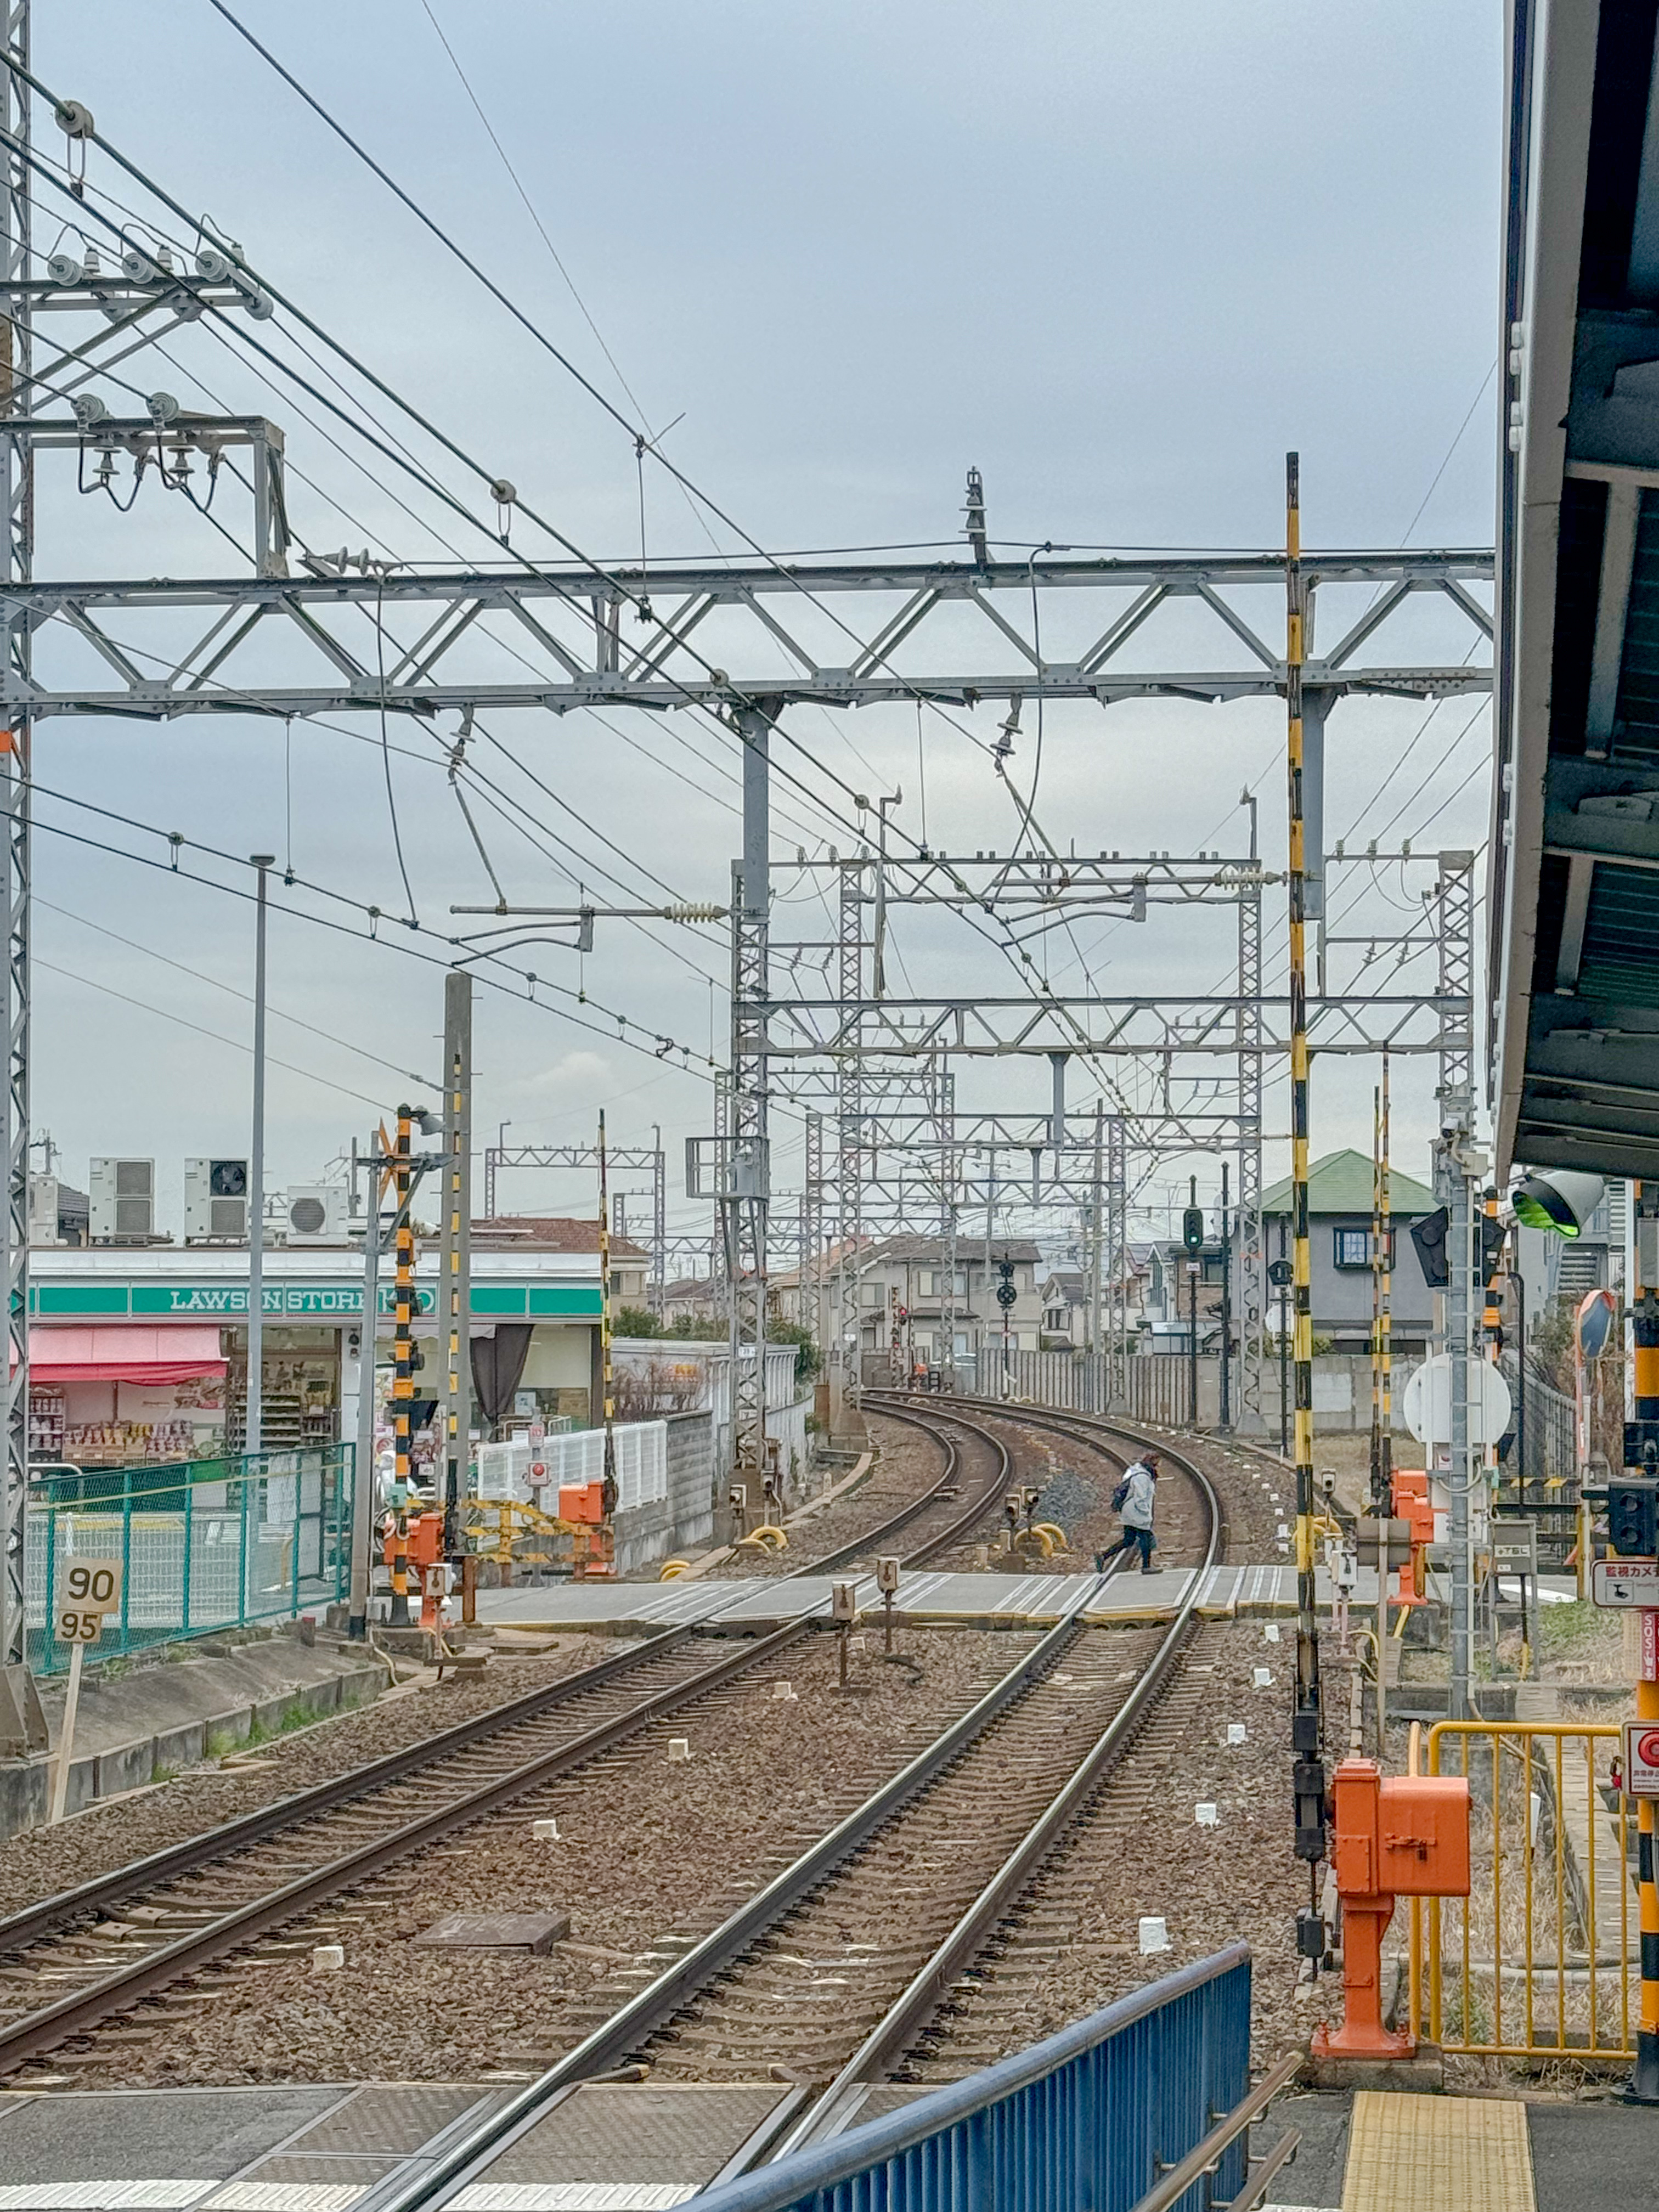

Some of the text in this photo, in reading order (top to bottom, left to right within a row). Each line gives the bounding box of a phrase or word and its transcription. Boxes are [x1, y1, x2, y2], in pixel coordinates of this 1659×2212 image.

[170, 1291, 281, 1310] LAWSN
[68, 1567, 114, 1602] 90
[61, 1613, 98, 1640] 95
[1644, 1615, 1653, 1650] SOS
